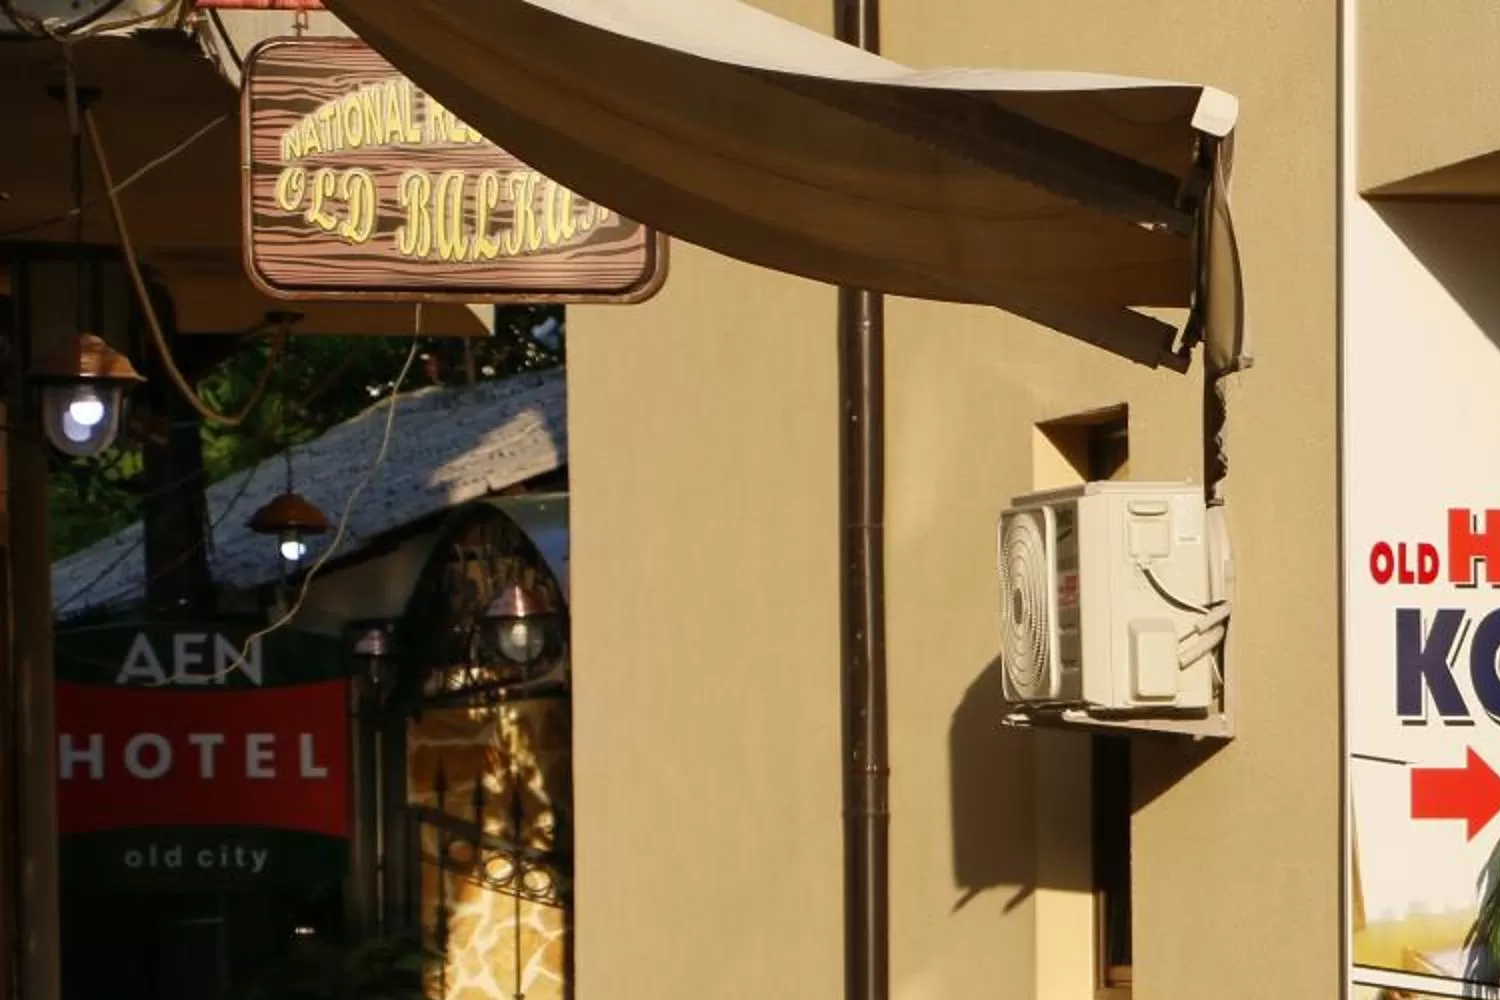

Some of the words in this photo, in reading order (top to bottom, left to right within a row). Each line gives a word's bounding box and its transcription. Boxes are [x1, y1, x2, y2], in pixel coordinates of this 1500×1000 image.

[281, 77, 422, 161] NATIONAL
[276, 167, 377, 243] OLD
[1369, 541, 1440, 585] OLD
[115, 632, 263, 687] AEN
[59, 732, 329, 780] HOTEL
[124, 845, 182, 869] old
[197, 845, 269, 874] city
